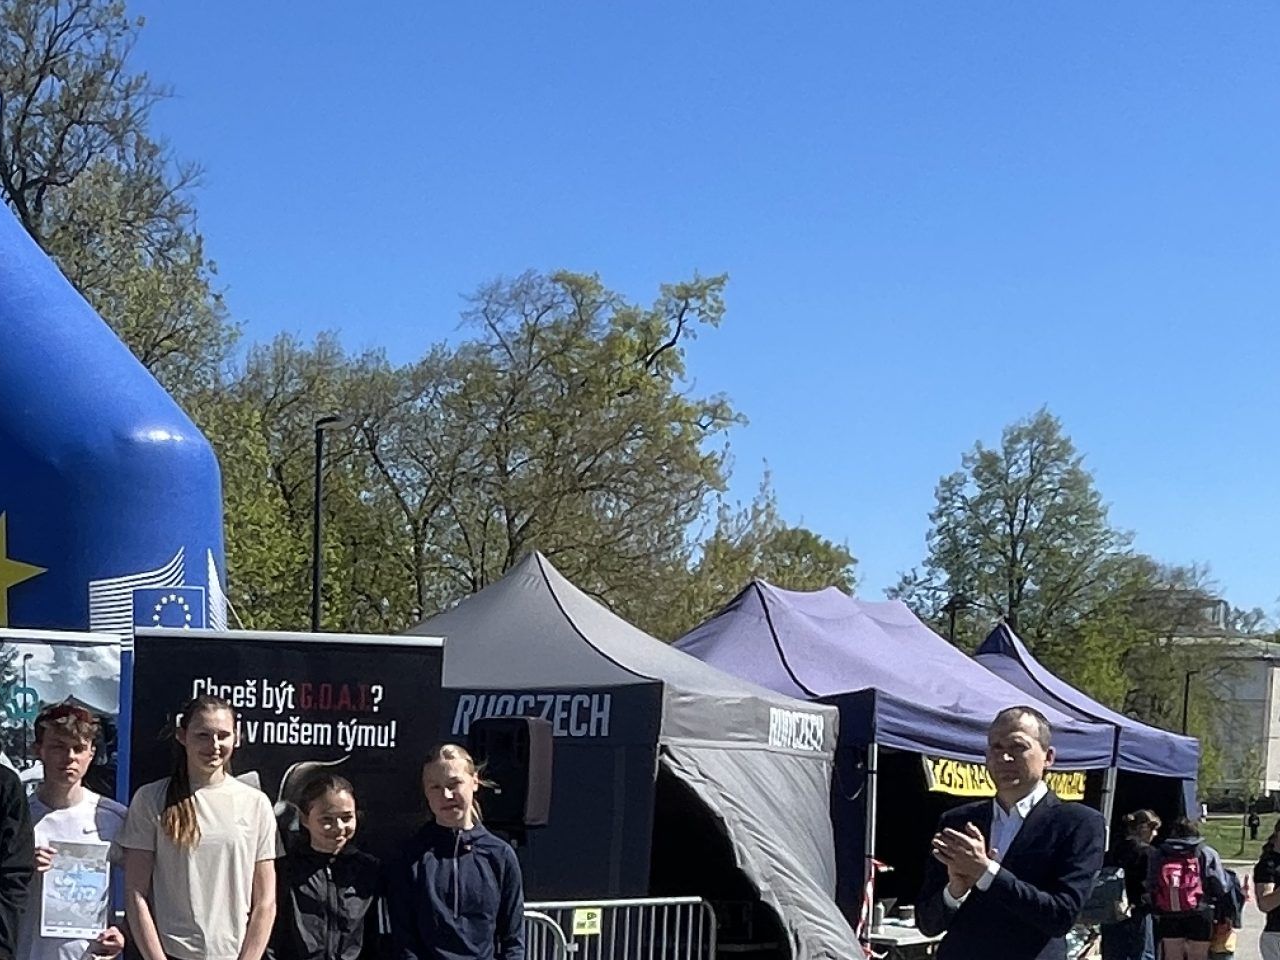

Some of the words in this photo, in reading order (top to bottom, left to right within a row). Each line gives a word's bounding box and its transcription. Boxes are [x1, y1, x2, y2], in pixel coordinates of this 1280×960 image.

[193, 677, 257, 708] Chceš
[262, 679, 296, 715] být
[246, 721, 260, 743] v
[263, 716, 332, 746] našem
[337, 718, 397, 752] týmu!
